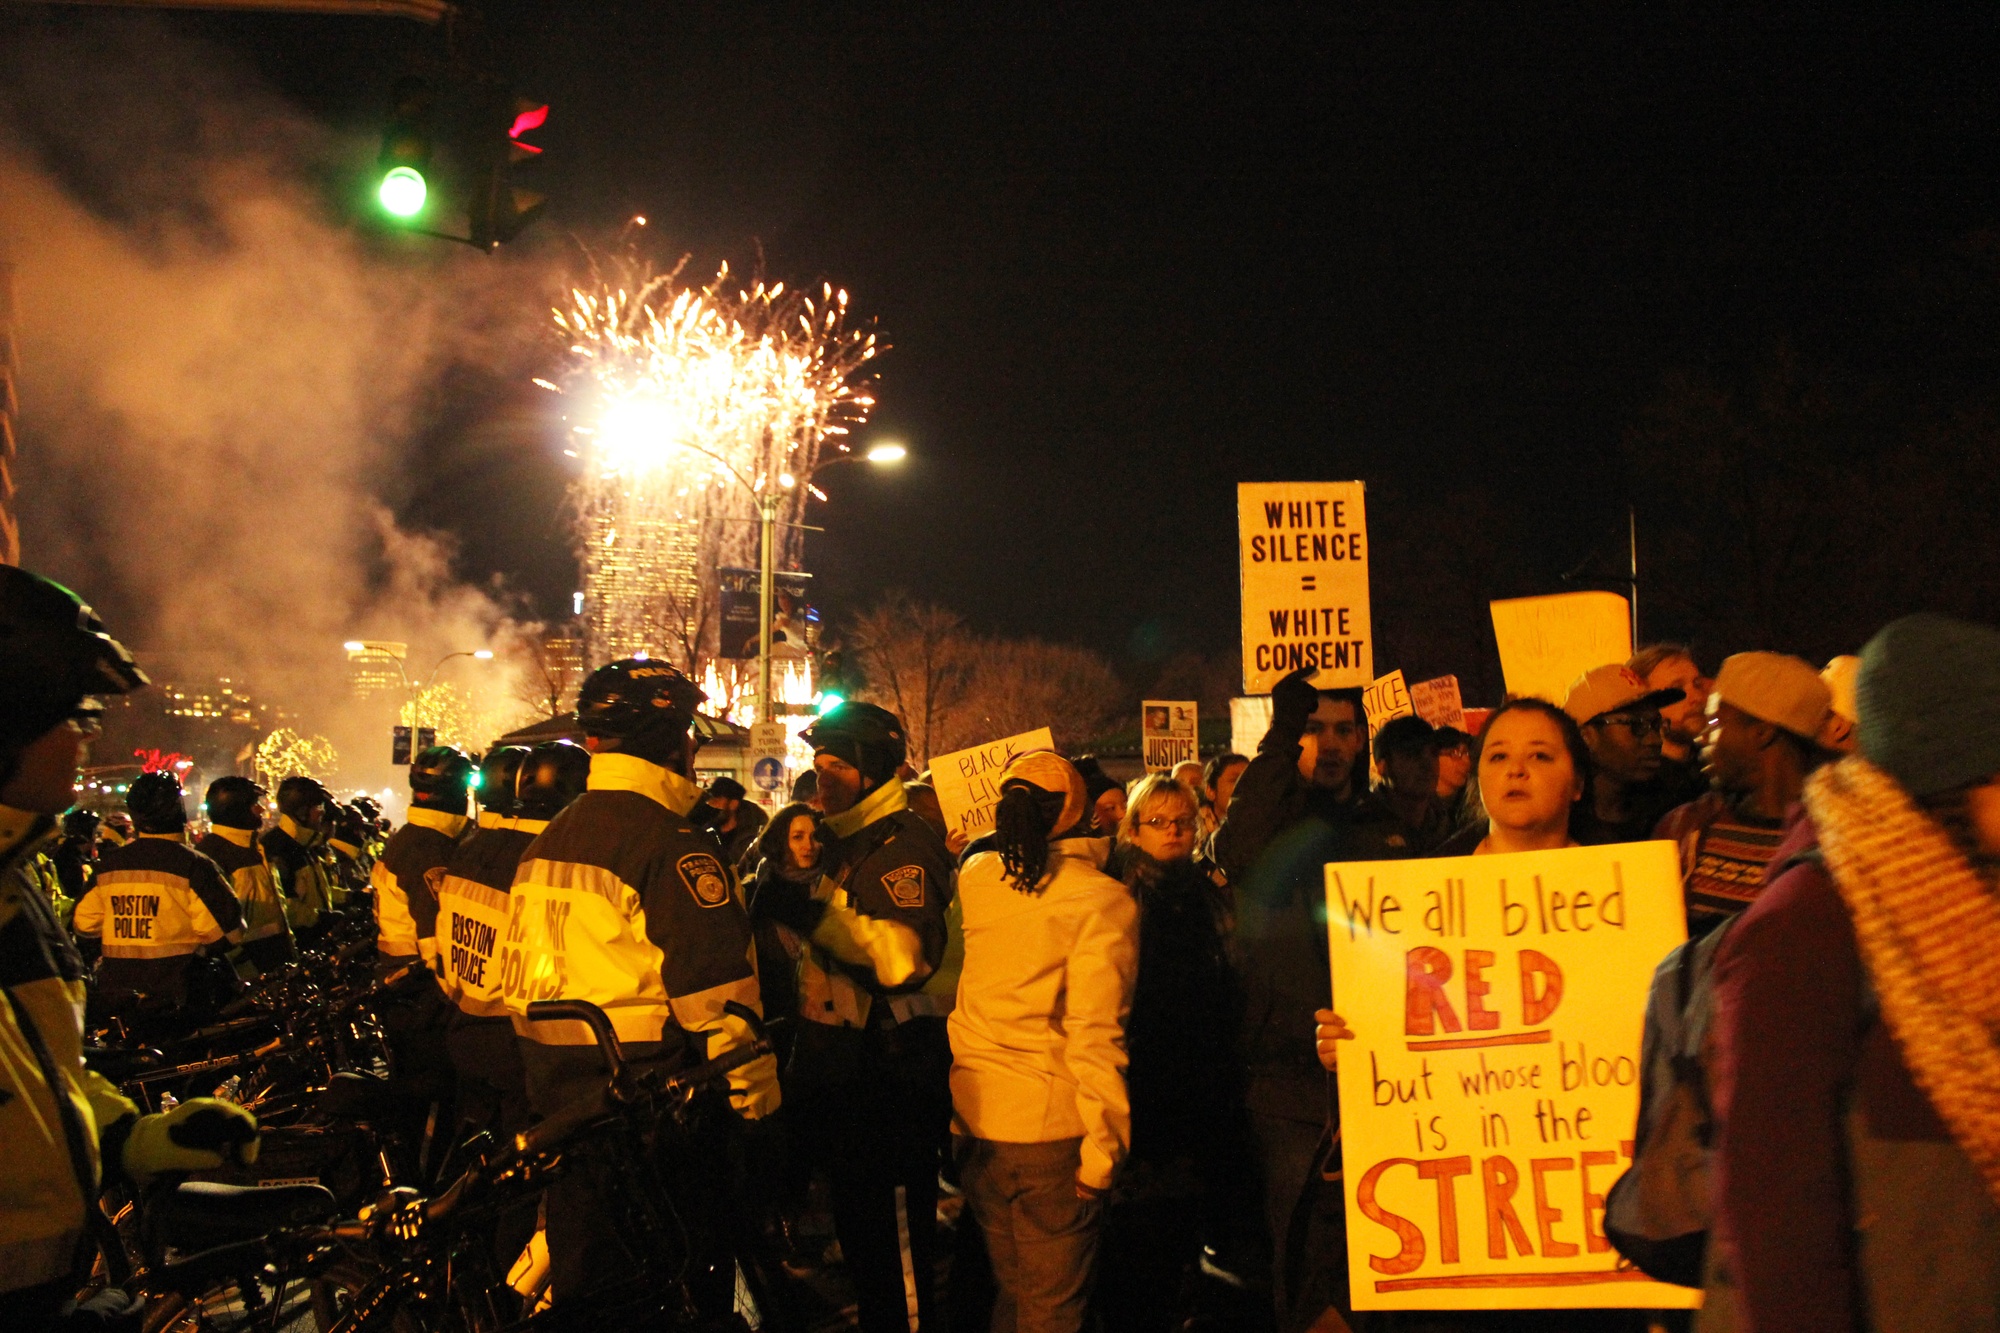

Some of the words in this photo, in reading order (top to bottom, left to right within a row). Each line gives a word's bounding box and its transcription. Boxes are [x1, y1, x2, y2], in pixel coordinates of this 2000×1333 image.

[1264, 501, 1346, 529] WHITE
[1251, 534, 1362, 562] SILENCE
[1269, 608, 1350, 637] WHITE
[1256, 641, 1364, 672] CONSENT
[958, 743, 1016, 778] BLACK
[1146, 738, 1193, 767] JUSTICE
[968, 774, 1003, 804] LIV
[111, 895, 160, 917] BOSTON
[1333, 871, 1402, 942] We
[1424, 878, 1465, 938] all
[1500, 861, 1626, 937] bleed
[114, 918, 153, 939] POLICE
[452, 912, 497, 958] BOSTON
[451, 945, 487, 988] POLICE
[1405, 946, 1564, 1036] RED
[1370, 1051, 1433, 1106] but
[1458, 1052, 1542, 1098] whose
[1559, 1041, 1637, 1092] bloo
[1414, 1112, 1447, 1152] is
[1479, 1106, 1510, 1148] in
[1535, 1099, 1593, 1143] the
